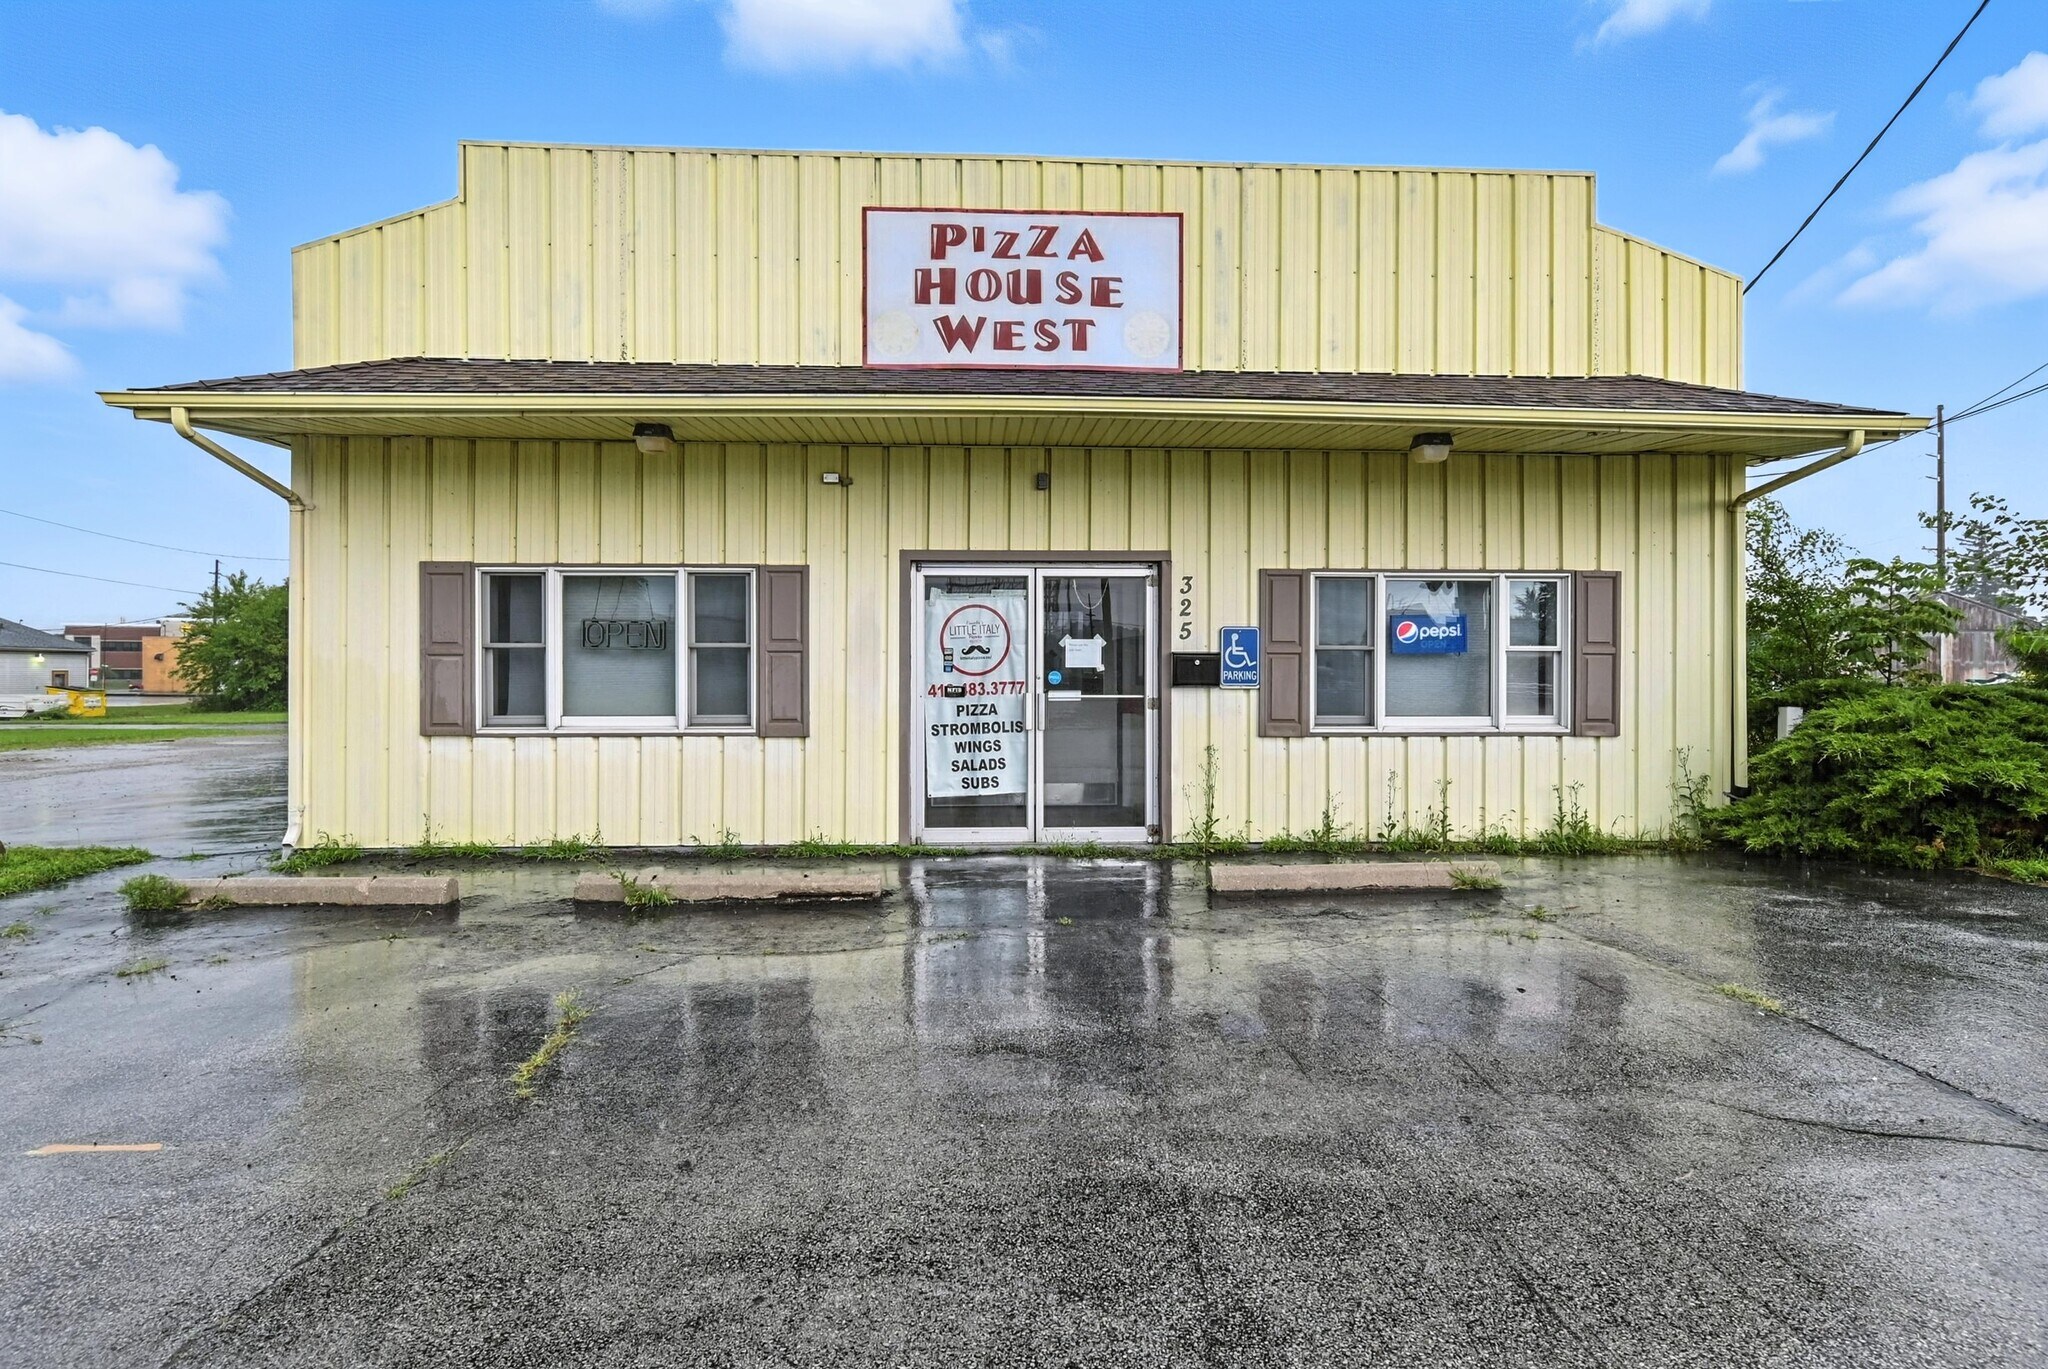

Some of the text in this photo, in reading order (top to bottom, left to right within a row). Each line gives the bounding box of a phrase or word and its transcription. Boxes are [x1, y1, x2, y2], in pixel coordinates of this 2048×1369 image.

[930, 223, 1105, 263] PIZZA
[914, 267, 1125, 309] HOUSE
[932, 314, 1096, 354] WEST
[585, 620, 664, 648] OPEN
[949, 624, 977, 636] LITTLE
[979, 623, 1000, 635] ITALY
[1419, 623, 1462, 640] pepsi
[1223, 670, 1257, 681] PARKING
[956, 703, 998, 717] PIZZA
[930, 720, 1024, 737] STROMBOLIS
[954, 739, 1002, 754] WINGS
[951, 757, 1007, 772] SALADS
[961, 776, 1000, 790] SUBS
